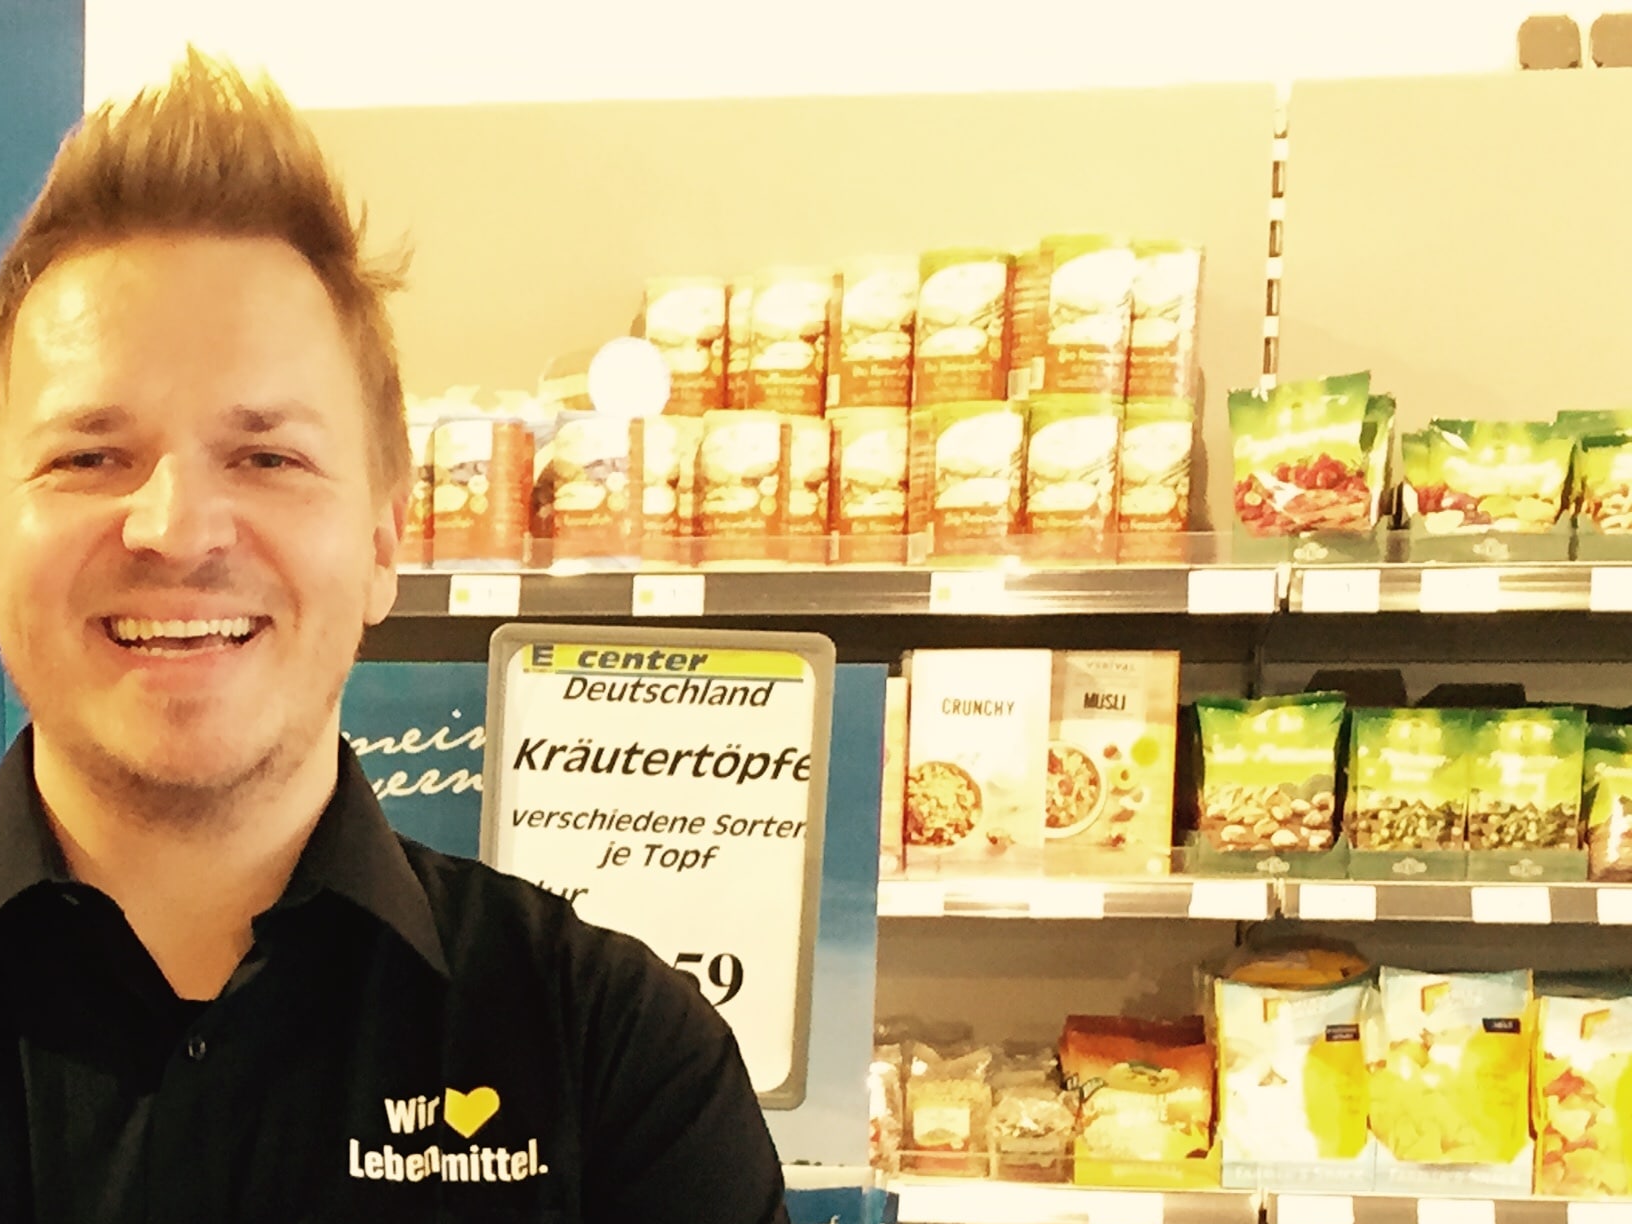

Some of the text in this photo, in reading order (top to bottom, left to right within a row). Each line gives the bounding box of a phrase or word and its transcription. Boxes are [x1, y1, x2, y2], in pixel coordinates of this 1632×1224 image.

[531, 644, 709, 672] E center
[562, 676, 776, 708] Deutschland
[941, 696, 1016, 717] CRUNCHY
[512, 737, 811, 786] Kräutertöpfe
[511, 808, 706, 834] verschiedene
[597, 840, 721, 873] je Topf
[384, 1094, 441, 1135] Wir
